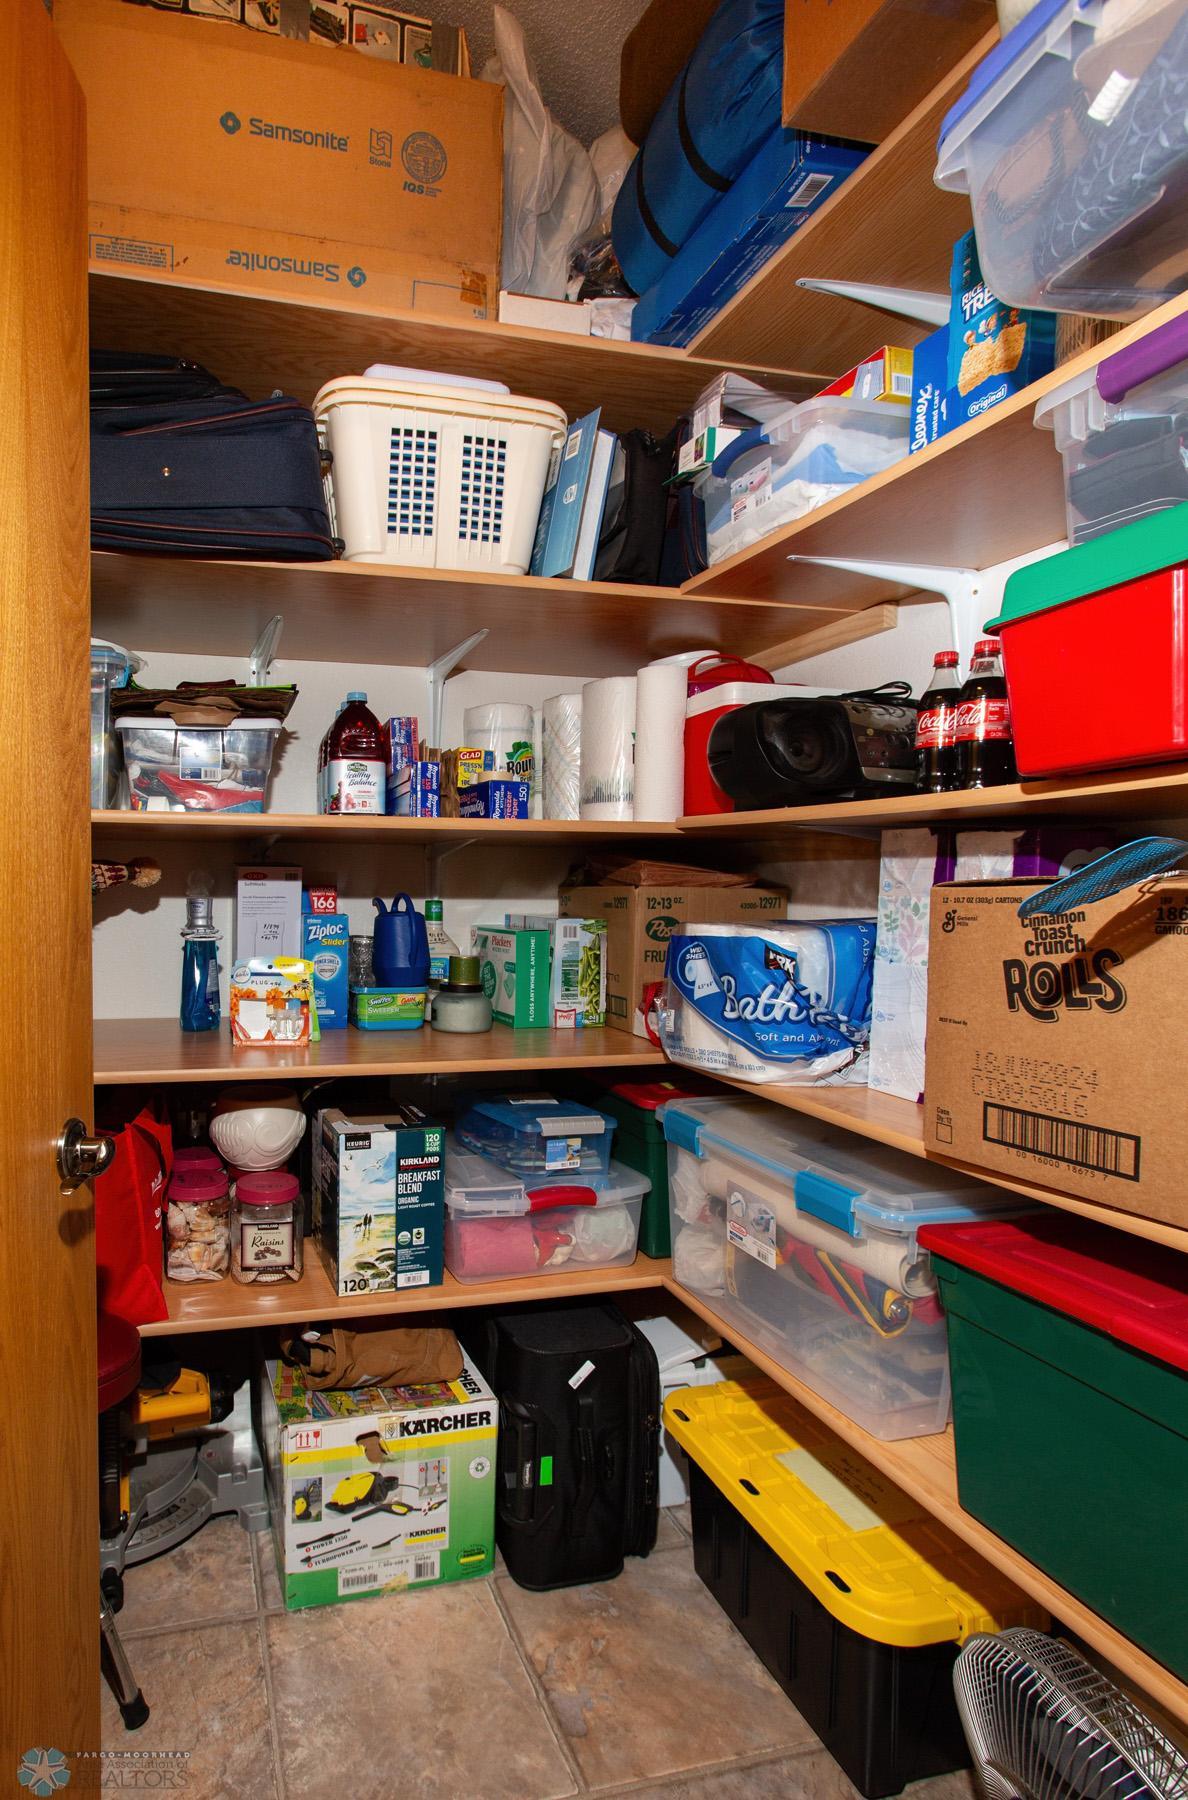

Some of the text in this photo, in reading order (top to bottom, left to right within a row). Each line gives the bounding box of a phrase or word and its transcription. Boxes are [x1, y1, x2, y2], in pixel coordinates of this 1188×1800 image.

[249, 118, 348, 152] Samsonite
[403, 181, 424, 194] IQS
[227, 249, 340, 283] Samsonite
[962, 281, 983, 307] RICE
[970, 387, 1005, 414] Original
[911, 383, 933, 453] leenex
[460, 751, 480, 760] GLAD
[519, 786, 527, 802] 150
[493, 790, 502, 819] Reynolds
[312, 896, 335, 909] 166
[1020, 910, 1086, 928] Cinnamon
[308, 924, 343, 941] Ziploc
[1032, 924, 1074, 942] Toast
[321, 938, 345, 946] Slider
[491, 935, 512, 948] Plackers
[1024, 934, 1087, 957] Crunch
[1002, 947, 1127, 1024] ROLLS
[721, 975, 809, 1022] Bath
[755, 1032, 778, 1042] Soft
[782, 1033, 804, 1042] and
[425, 1133, 440, 1142] 120
[400, 1156, 440, 1166] KIRKLAND
[1032, 1154, 1060, 1168] 16000
[398, 1170, 441, 1184] BREAKFAST
[398, 1183, 422, 1195] BLEND
[398, 1196, 420, 1205] ORGANIC
[251, 1235, 284, 1248] Raisins
[343, 1278, 366, 1293] 120
[399, 1410, 491, 1438] KÄRCHER
[409, 1526, 447, 1538] KÄRCHER
